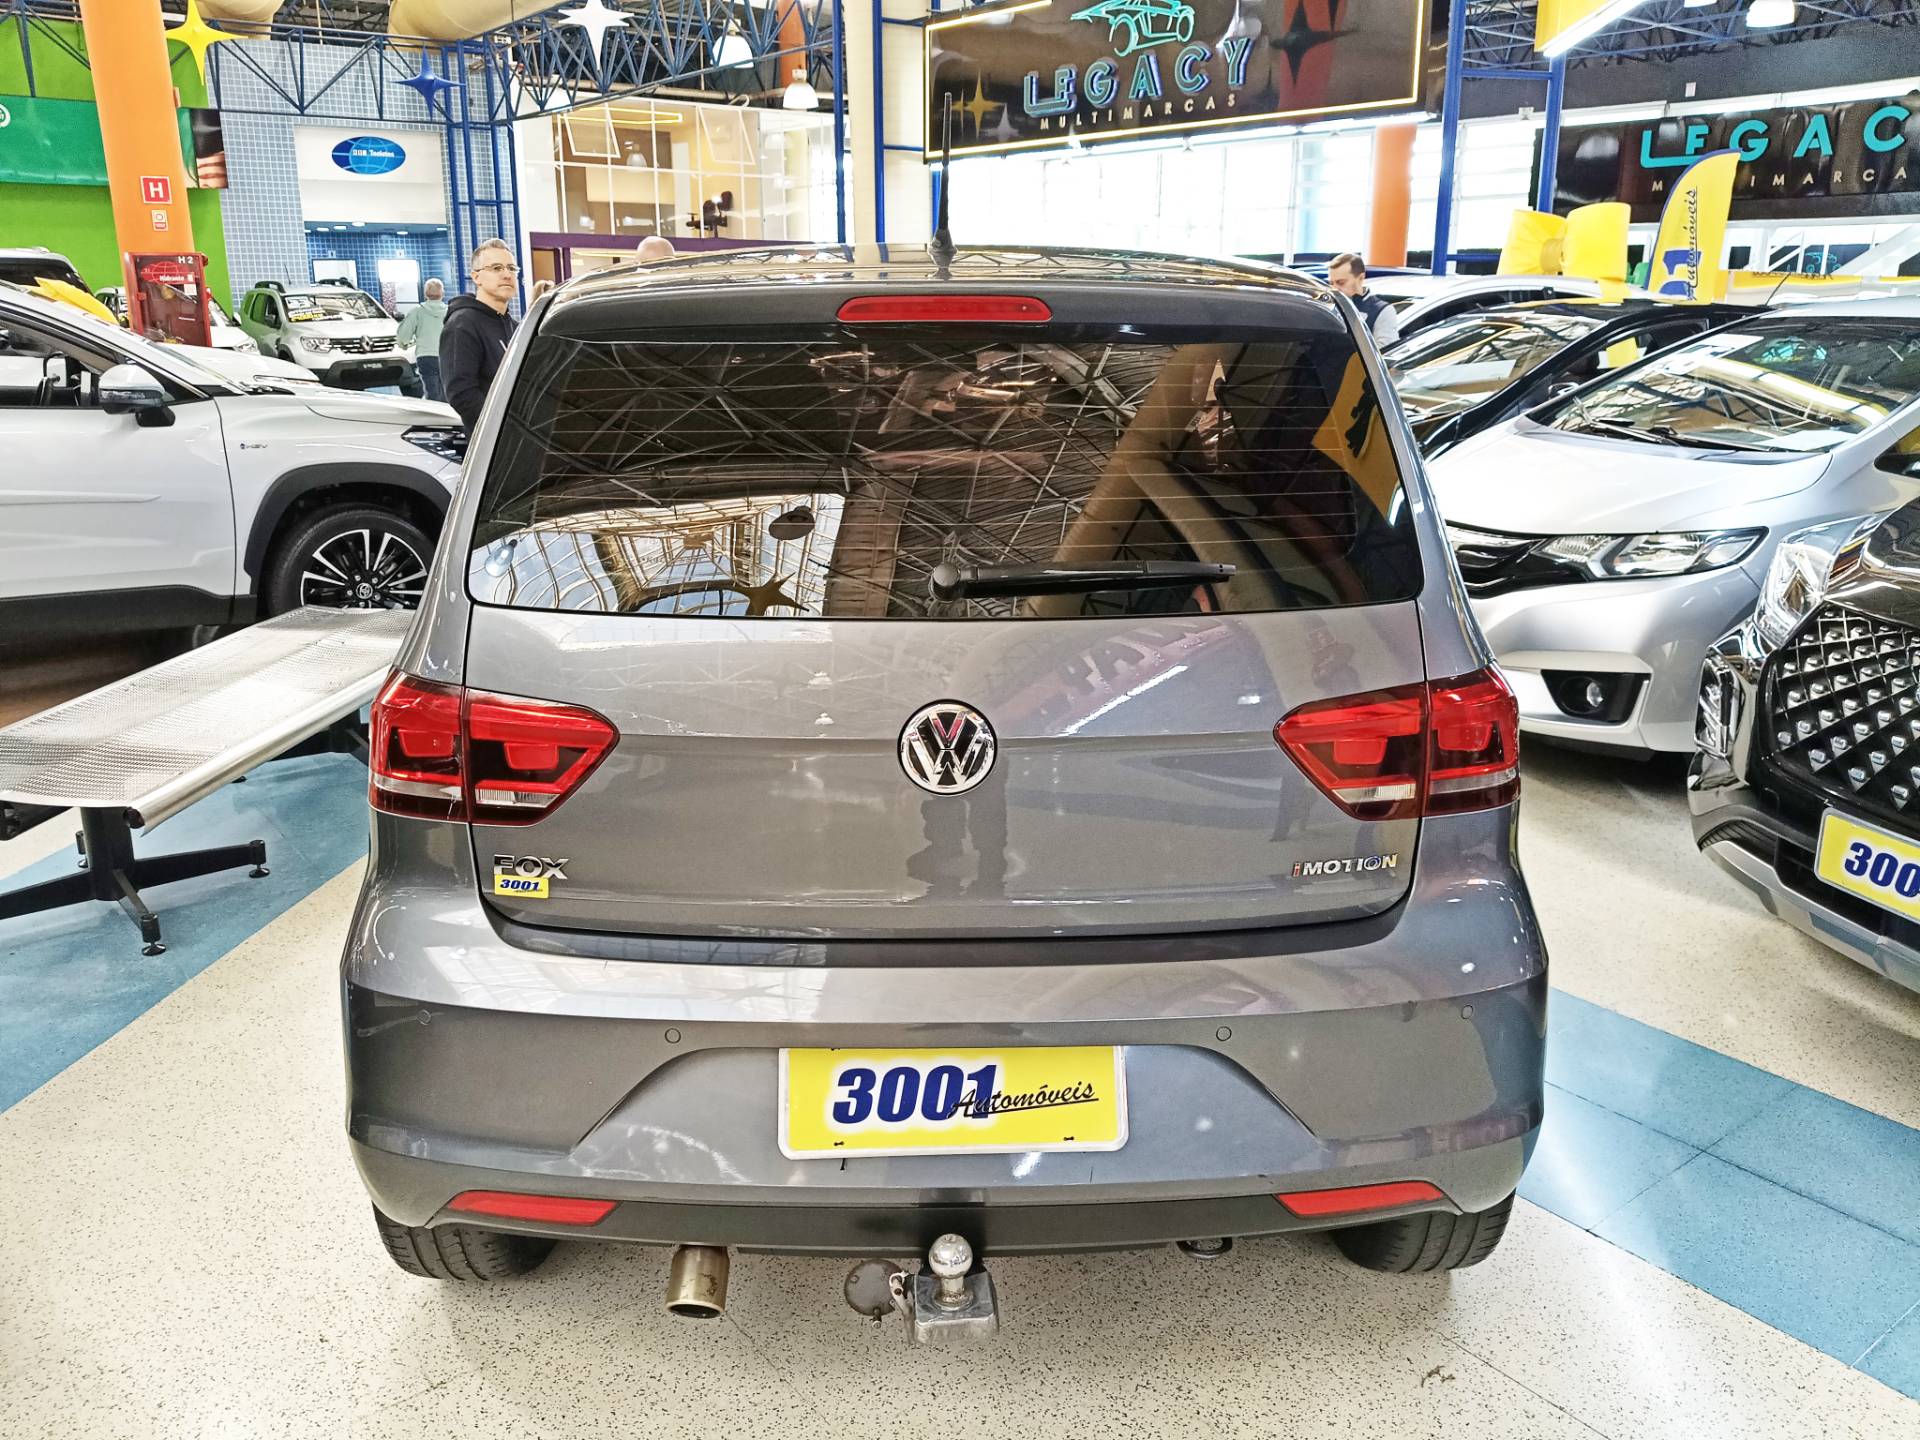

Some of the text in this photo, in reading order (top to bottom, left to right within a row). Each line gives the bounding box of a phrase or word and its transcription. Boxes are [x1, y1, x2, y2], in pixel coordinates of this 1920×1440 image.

[1023, 37, 1254, 117] LEGACY
[1040, 93, 1236, 130] MULTIMARCAS
[1640, 105, 1911, 168] LEGAC
[148, 182, 164, 199] H
[1651, 166, 1908, 192] MIMARCA
[178, 255, 194, 264] H 2
[494, 854, 569, 880] FOX
[500, 879, 540, 891] 3001
[1844, 842, 1920, 898] 300
[832, 1064, 997, 1124] 3001
[946, 1080, 1099, 1118] Automóveis
